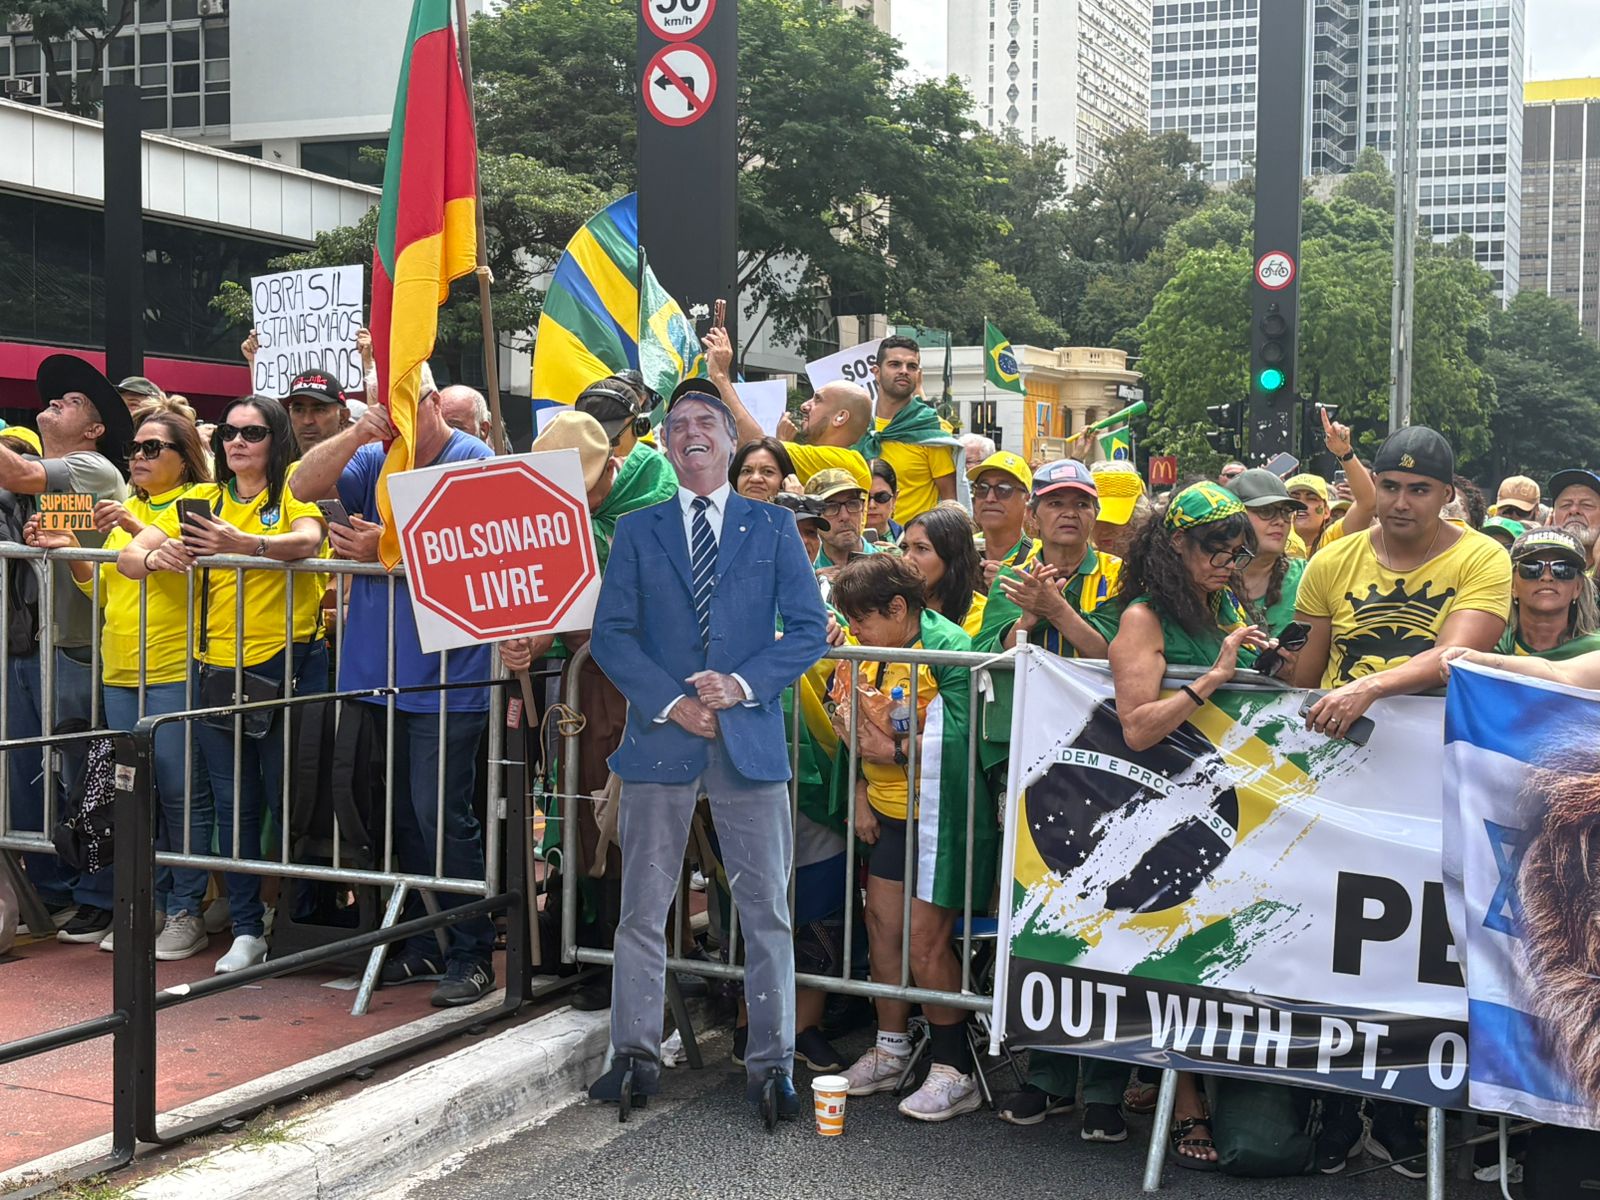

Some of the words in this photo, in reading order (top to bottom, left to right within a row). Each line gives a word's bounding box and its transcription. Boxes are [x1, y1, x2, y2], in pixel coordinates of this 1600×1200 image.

[664, 16, 692, 27] km/h
[40, 494, 92, 511] SUPREMO
[52, 514, 58, 528] O
[63, 514, 92, 528] POVO
[422, 511, 571, 565] BOLSONARO
[465, 563, 549, 612] LIVRE
[1108, 760, 1120, 772] E
[1020, 971, 1126, 1043] OUT
[1146, 990, 1292, 1069] WITH
[1316, 1017, 1400, 1090] PT,
